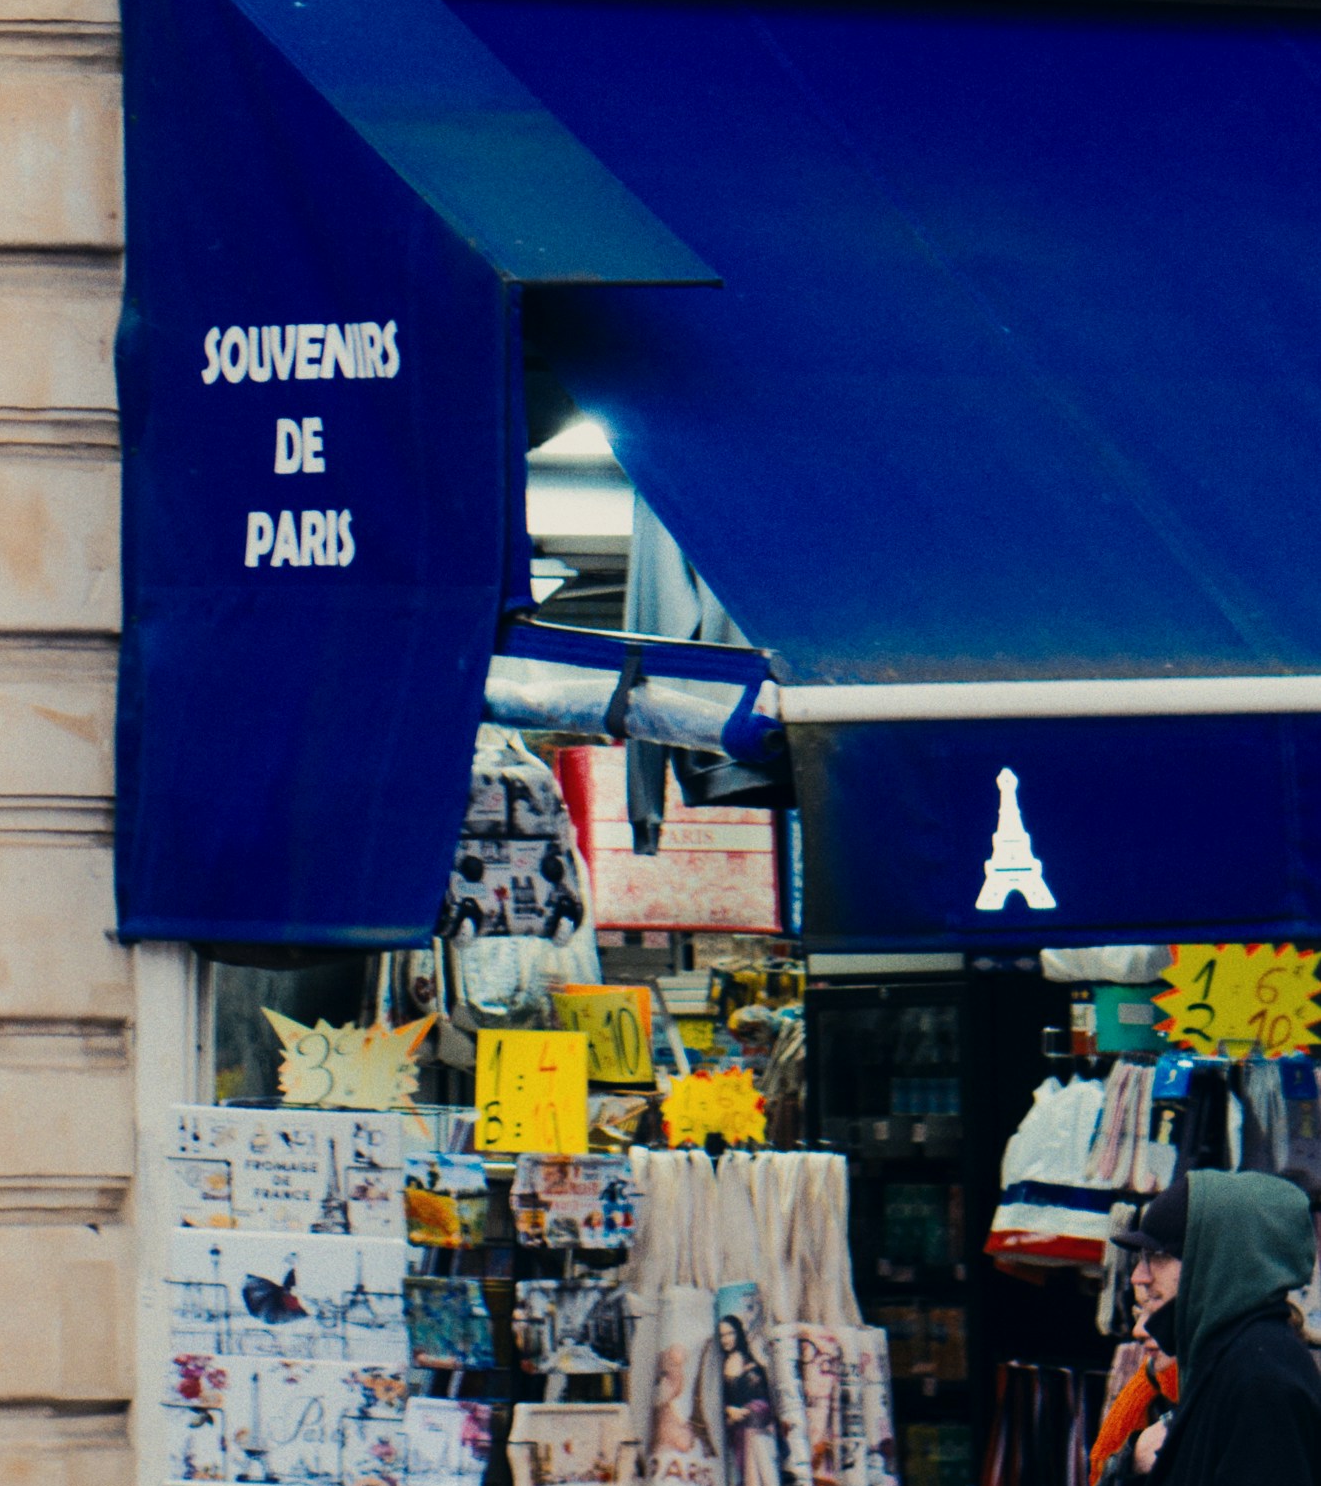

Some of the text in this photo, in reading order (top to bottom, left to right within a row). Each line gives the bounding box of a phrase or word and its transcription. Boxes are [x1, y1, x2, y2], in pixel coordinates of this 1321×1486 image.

[201, 319, 401, 385] SOUVENIRS
[274, 416, 325, 474] DE
[244, 508, 356, 567] PARIS
[1192, 959, 1217, 1001] 1
